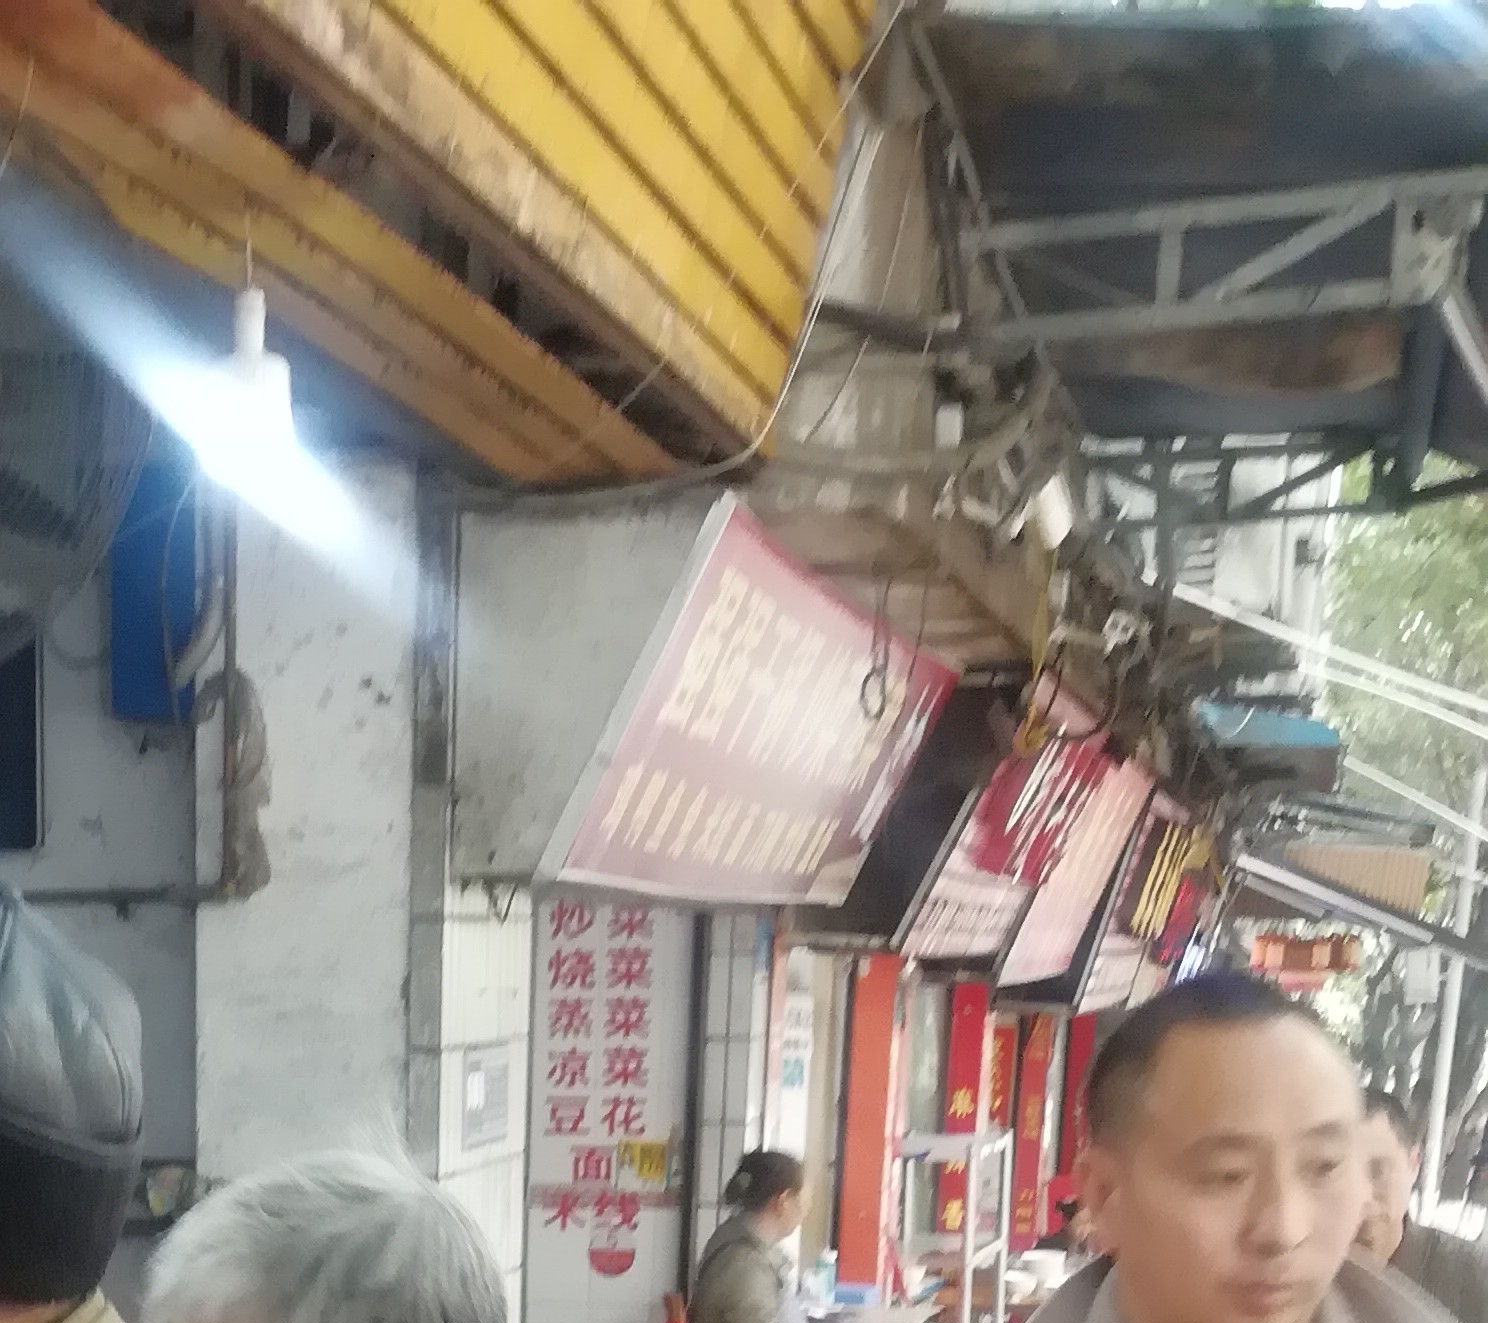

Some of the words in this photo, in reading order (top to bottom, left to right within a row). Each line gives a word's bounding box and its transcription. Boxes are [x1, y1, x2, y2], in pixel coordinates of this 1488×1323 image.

[547, 946, 654, 990] 烧菜
[543, 1094, 648, 1137] 豆花
[569, 1144, 615, 1184] 面
